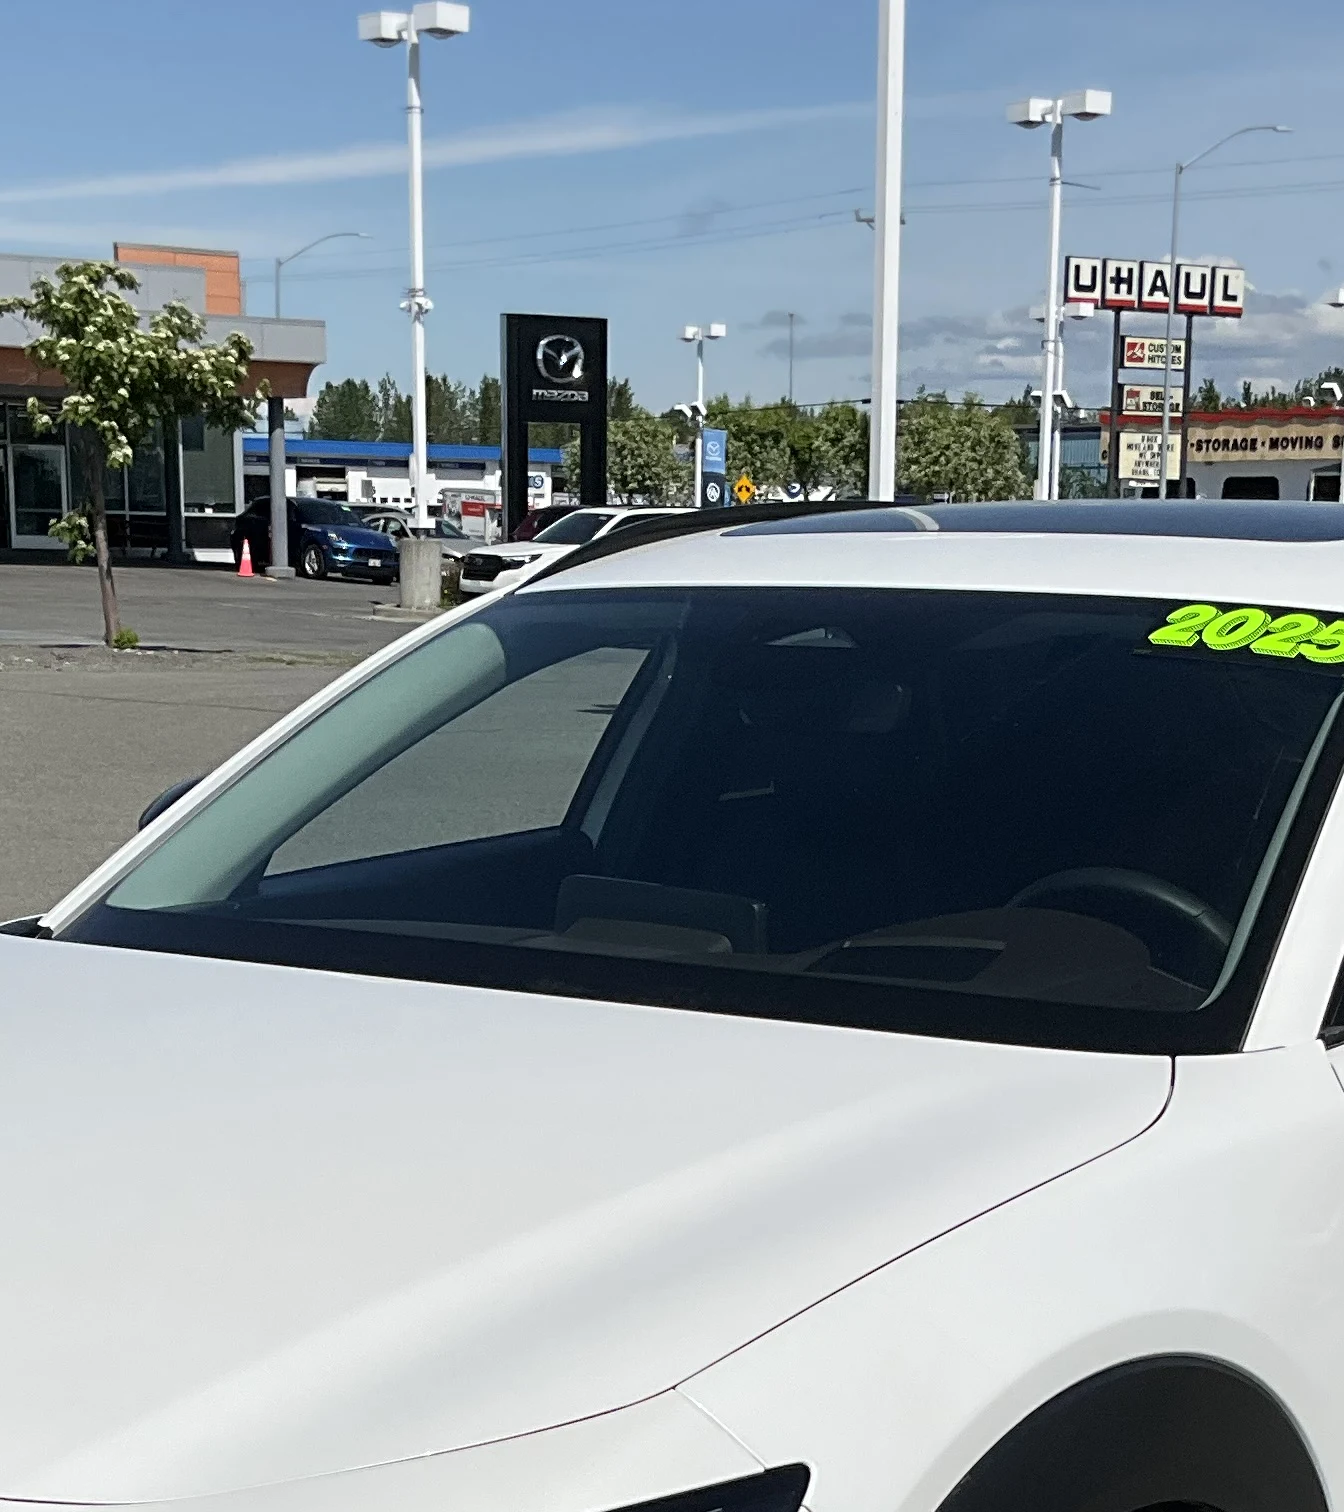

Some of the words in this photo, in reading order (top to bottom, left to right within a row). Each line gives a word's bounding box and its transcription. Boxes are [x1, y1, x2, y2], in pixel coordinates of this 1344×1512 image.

[1148, 343, 1181, 354] CUSTM
[1148, 354, 1182, 365] HITCES
[1143, 402, 1180, 412] STORGE
[1195, 438, 1257, 452] STORAGE
[1269, 436, 1323, 450] MOVING
